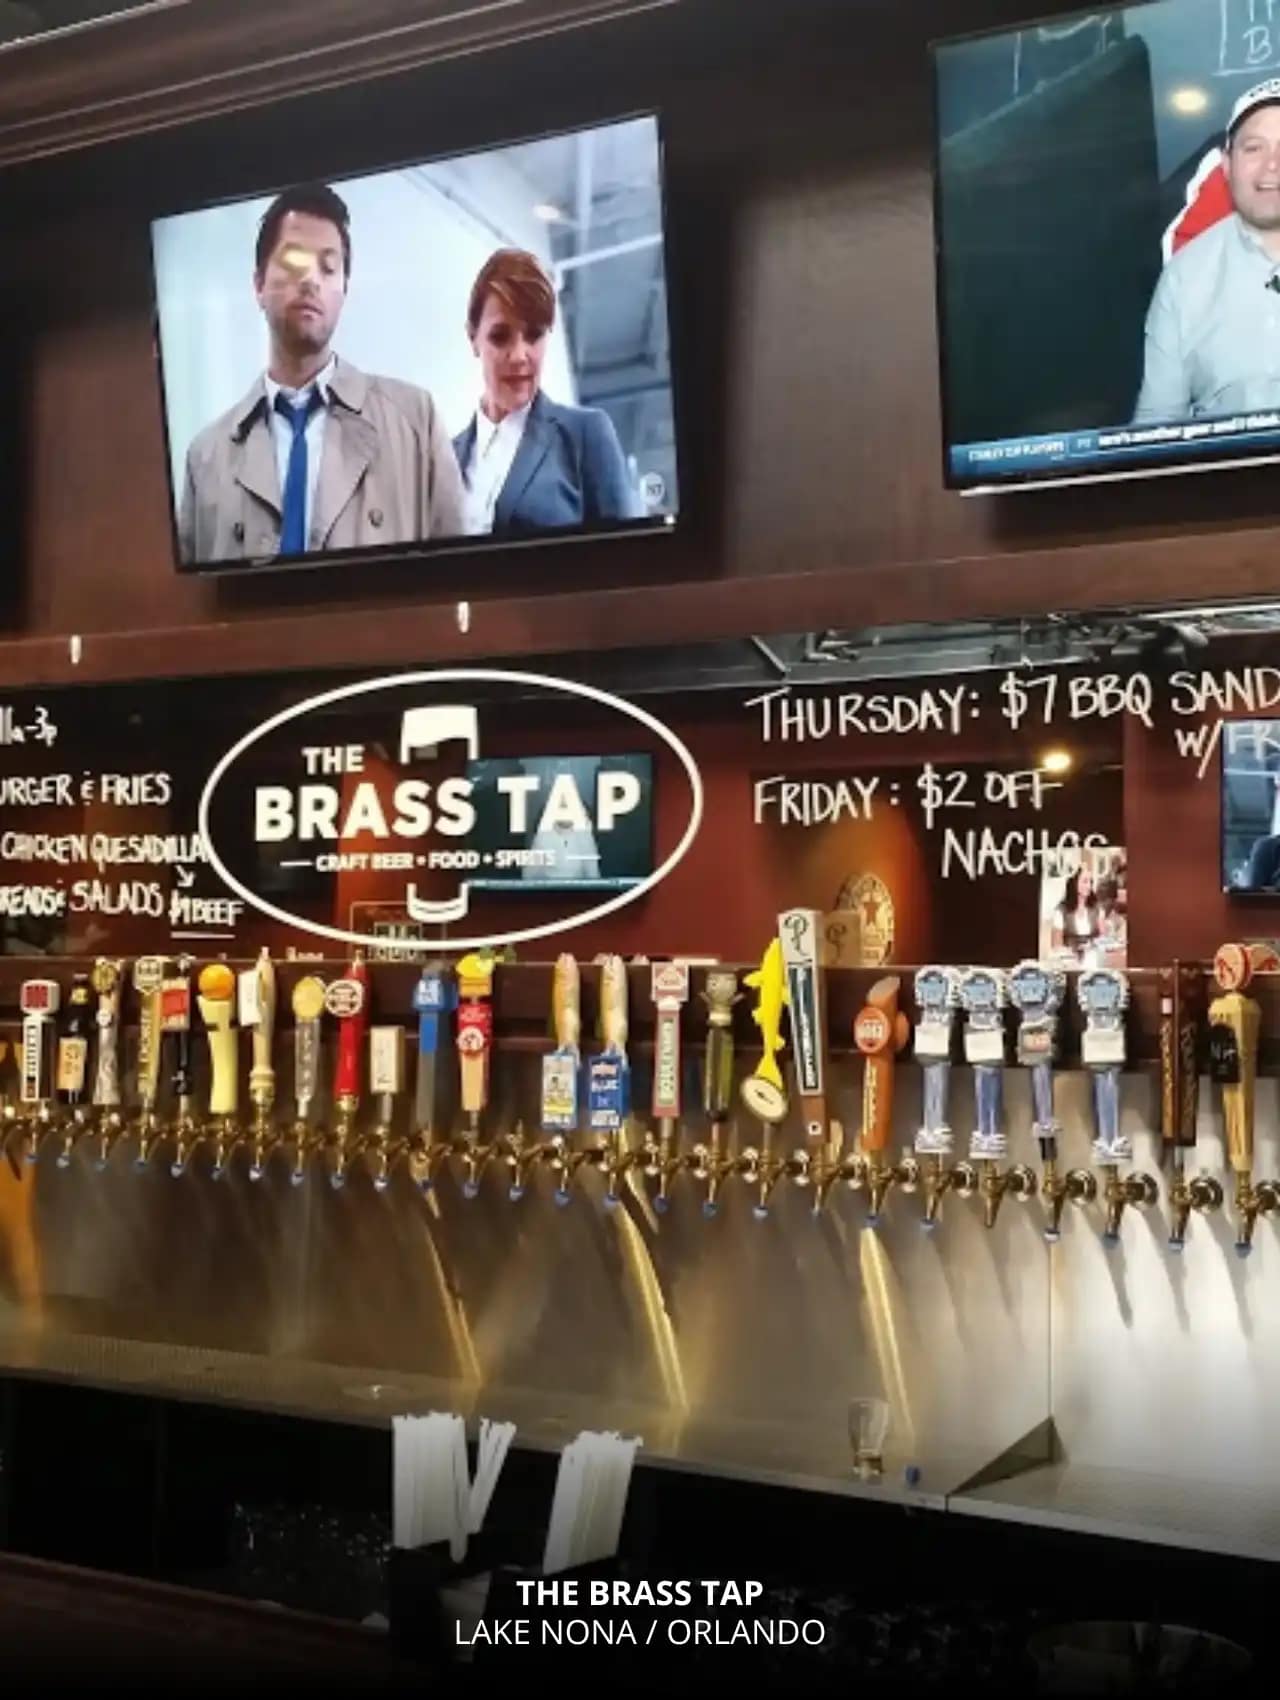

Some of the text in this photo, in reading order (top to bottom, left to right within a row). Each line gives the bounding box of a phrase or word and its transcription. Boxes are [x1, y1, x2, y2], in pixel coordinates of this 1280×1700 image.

[745, 684, 981, 742] THURSDAY:
[1000, 671, 1057, 730] $7
[1069, 672, 1154, 728] BBQ
[303, 745, 365, 774] THE
[101, 772, 171, 806] FRIES
[254, 771, 641, 841] BRASS TAP
[916, 762, 976, 829] $2
[984, 766, 1064, 811] OFF
[315, 853, 368, 872] CRAFT
[371, 852, 414, 870] BEER
[428, 851, 479, 869] FOOD
[69, 880, 164, 917] SALADS
[191, 897, 245, 926] BEEF
